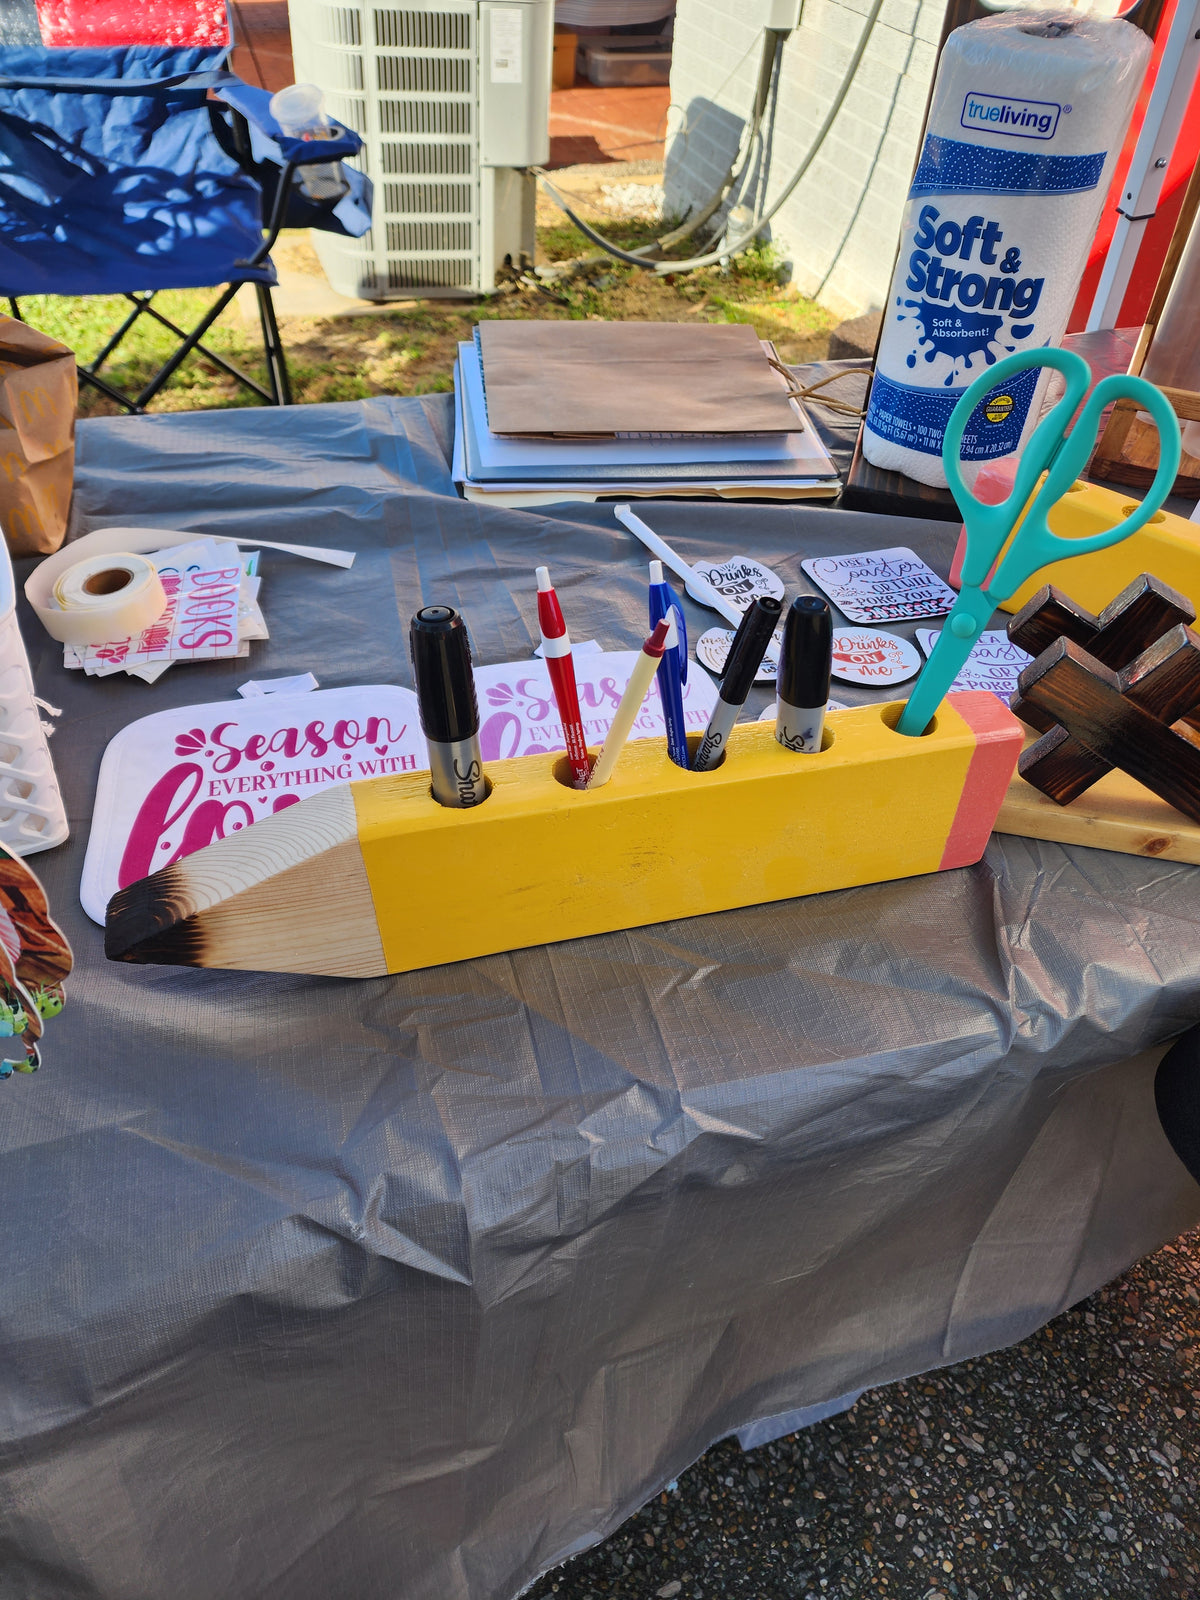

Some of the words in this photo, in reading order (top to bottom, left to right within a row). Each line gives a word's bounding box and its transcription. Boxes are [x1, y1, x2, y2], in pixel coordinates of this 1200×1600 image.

[968, 100, 1052, 133] trueliving
[913, 204, 1003, 266] Soft
[999, 247, 1022, 274] &
[905, 249, 1046, 319] Strong
[931, 327, 990, 338] Absorbent!
[932, 318, 952, 328] Soft
[954, 319, 963, 328] &
[879, 408, 893, 424] PAPER
[892, 415, 913, 431] TOWELS
[917, 424, 928, 436] 100
[698, 564, 763, 587] Drinks
[722, 583, 748, 595] ON
[898, 589, 932, 601] YOU
[178, 567, 240, 650] BOOKS
[833, 636, 899, 653] Drinks
[850, 655, 879, 664] ON
[858, 665, 892, 677] me
[210, 716, 407, 774] Season
[208, 763, 353, 798] EVERYTHING
[357, 753, 418, 777] WITH
